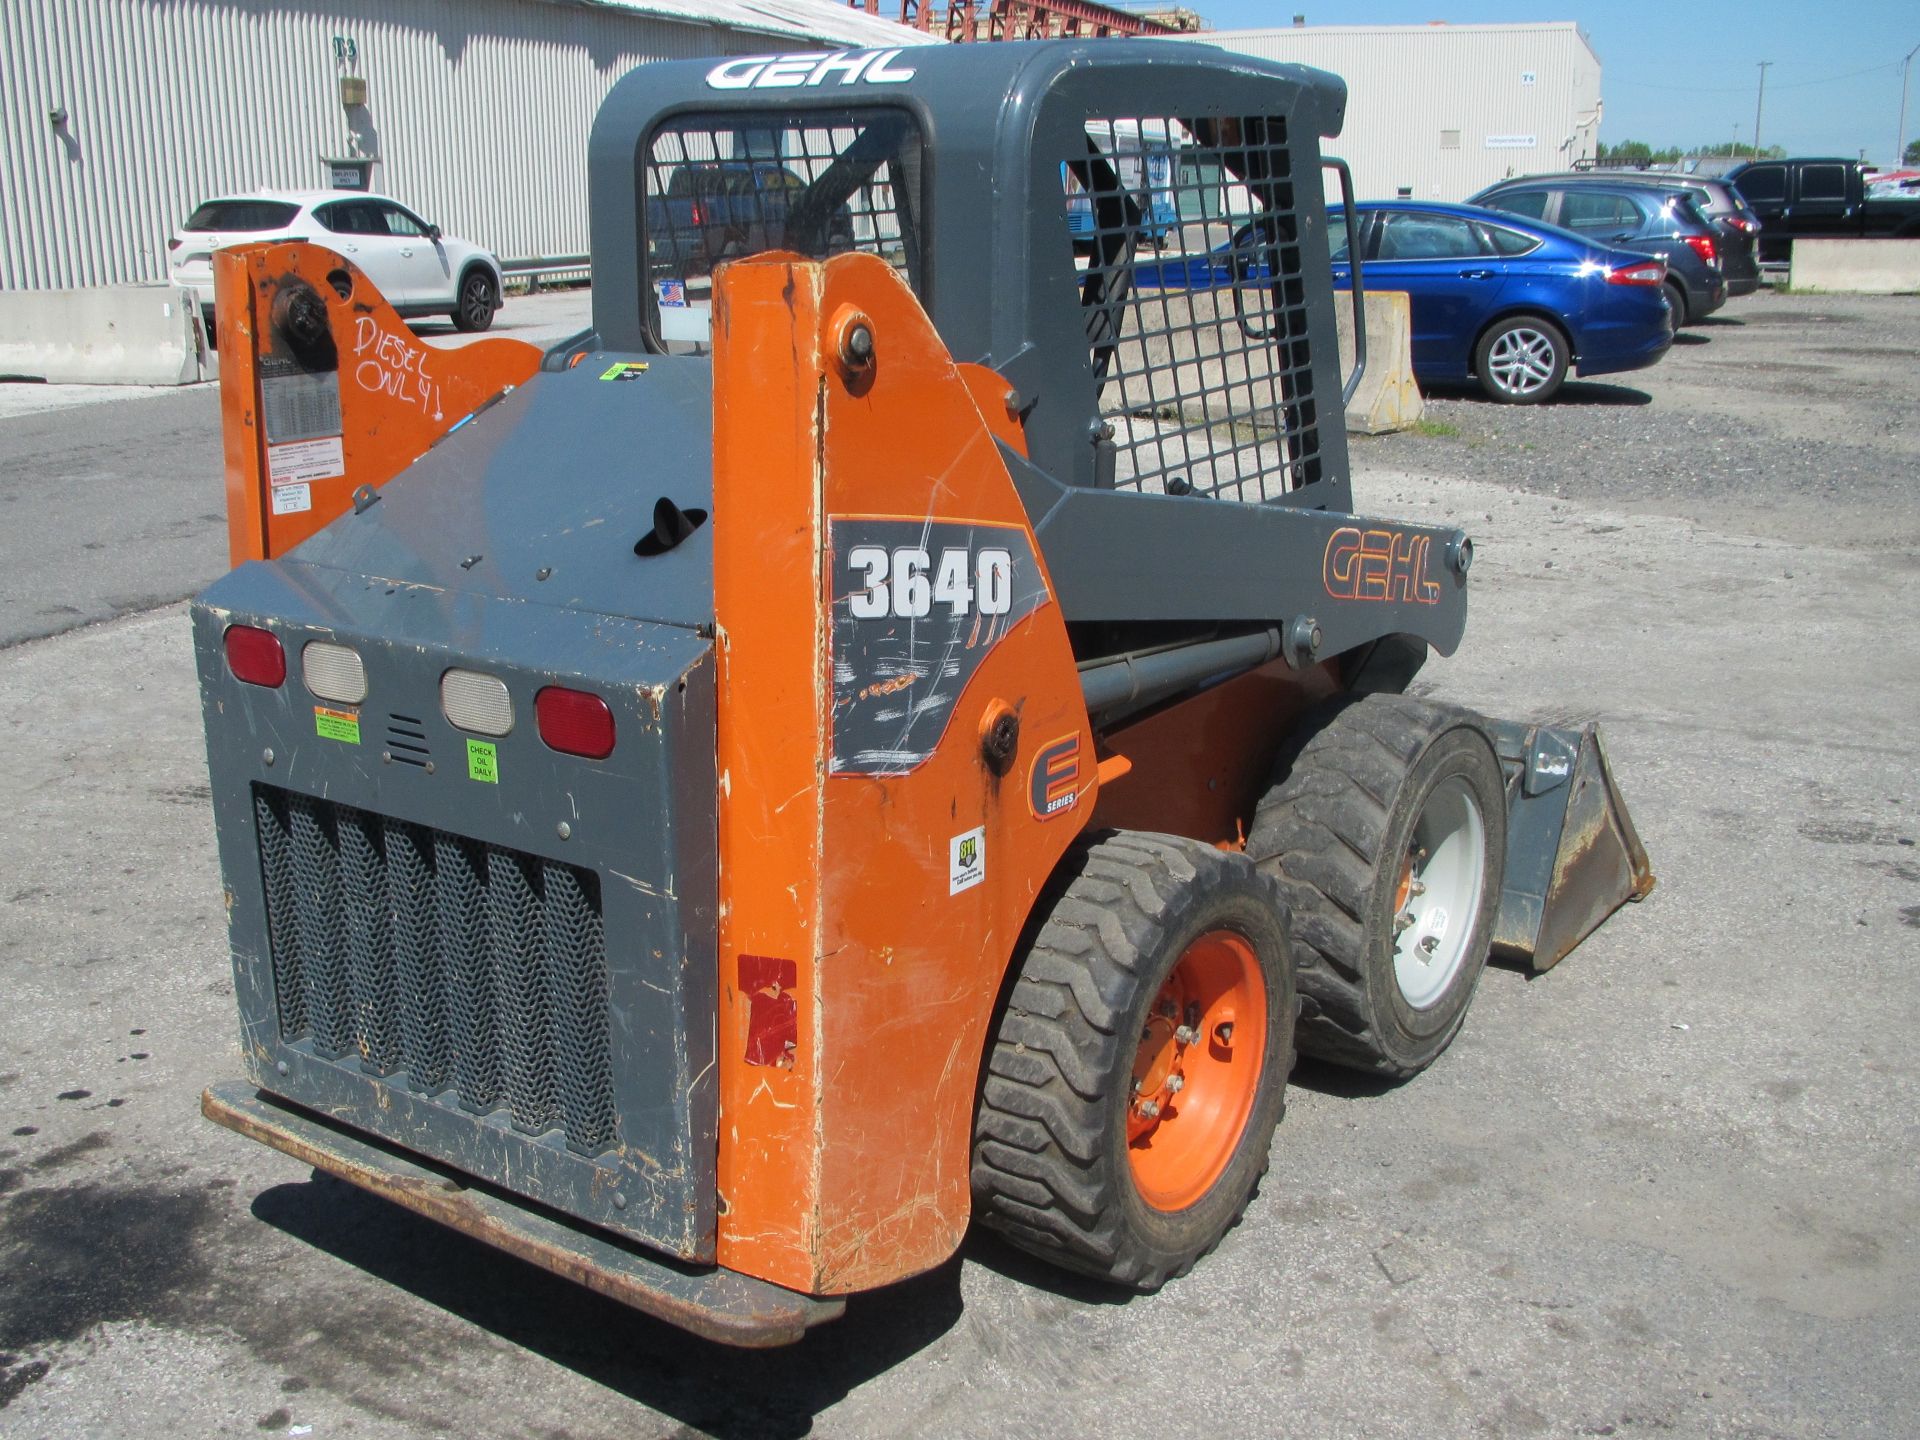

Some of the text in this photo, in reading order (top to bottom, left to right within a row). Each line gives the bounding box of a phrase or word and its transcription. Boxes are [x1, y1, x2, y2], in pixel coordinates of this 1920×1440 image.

[332, 36, 357, 58] T3
[705, 49, 917, 90] GEHL
[353, 317, 432, 379] DIESEL
[1322, 527, 1441, 604] GEHL
[848, 547, 1012, 619] 3640
[470, 745, 493, 758] CHECK
[476, 757, 488, 766] OIL
[474, 766, 492, 777] DAILY
[1027, 730, 1080, 821] E
[1047, 793, 1075, 813] SERIES
[960, 837, 976, 860] 811
